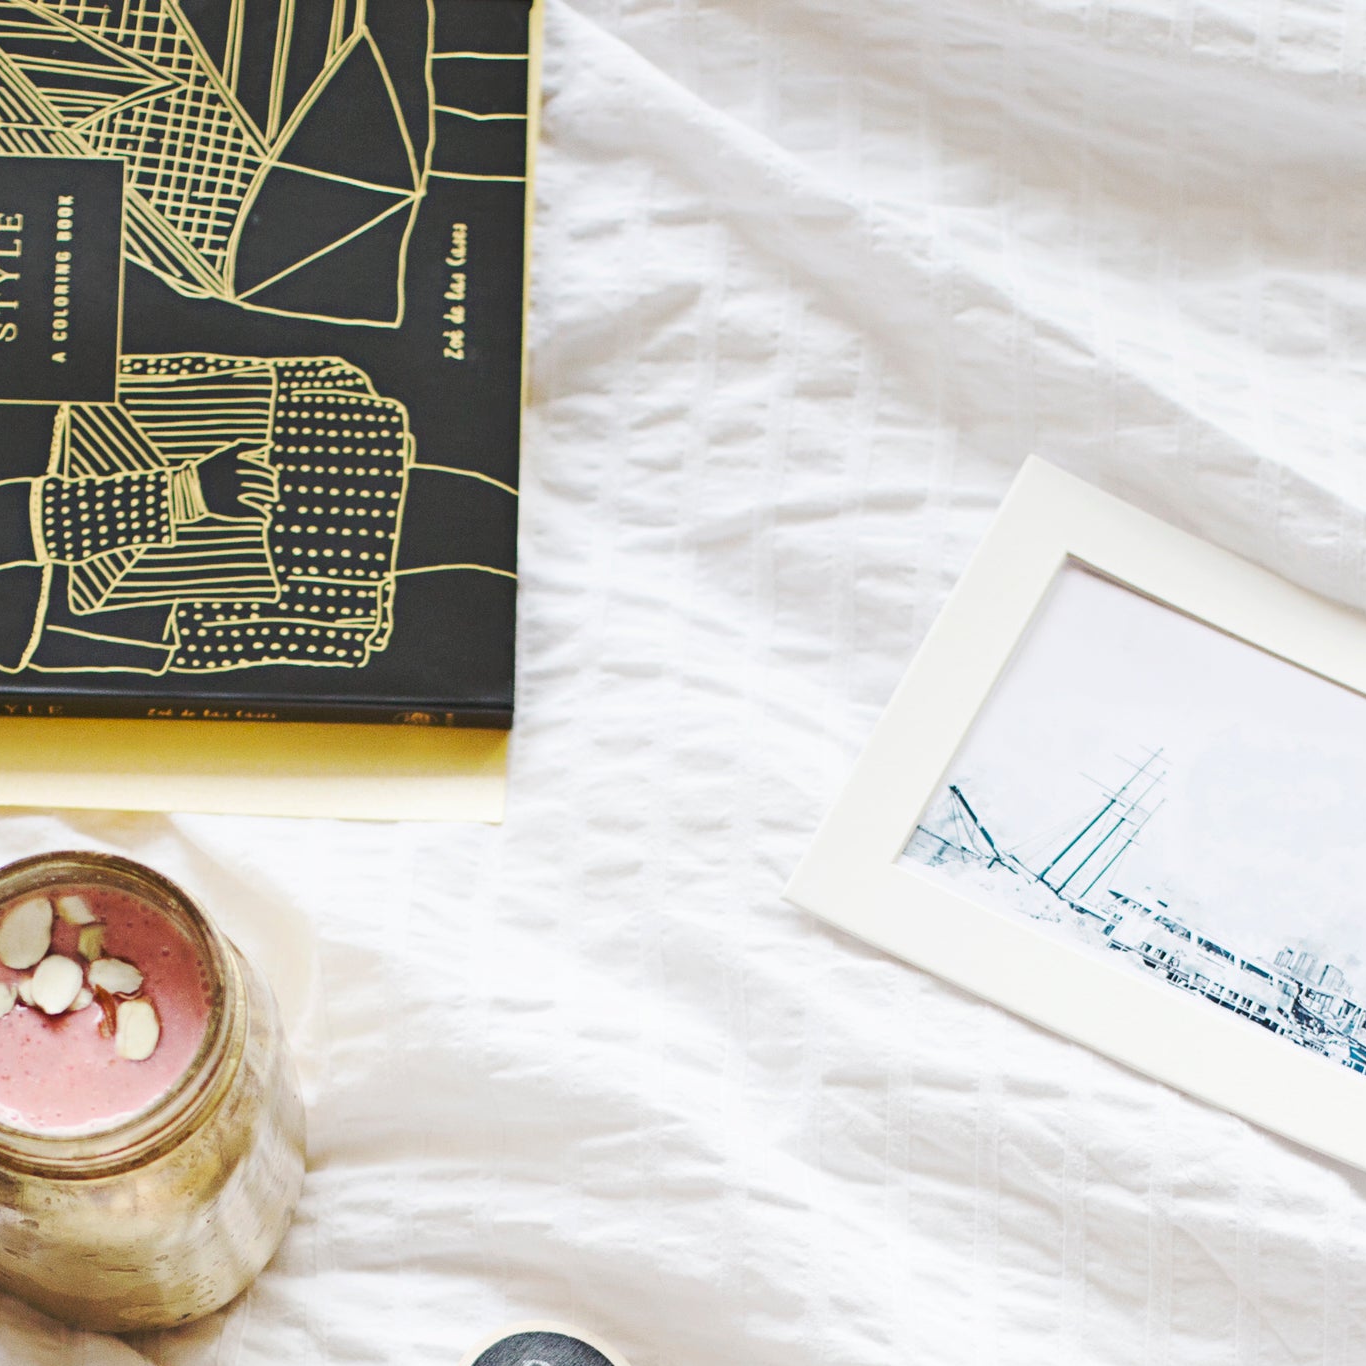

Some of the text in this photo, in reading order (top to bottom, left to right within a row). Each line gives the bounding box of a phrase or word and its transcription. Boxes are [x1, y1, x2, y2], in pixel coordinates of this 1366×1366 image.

[51, 195, 74, 363] A COLORING BOOK
[444, 273, 467, 300] las
[443, 305, 466, 324] de
